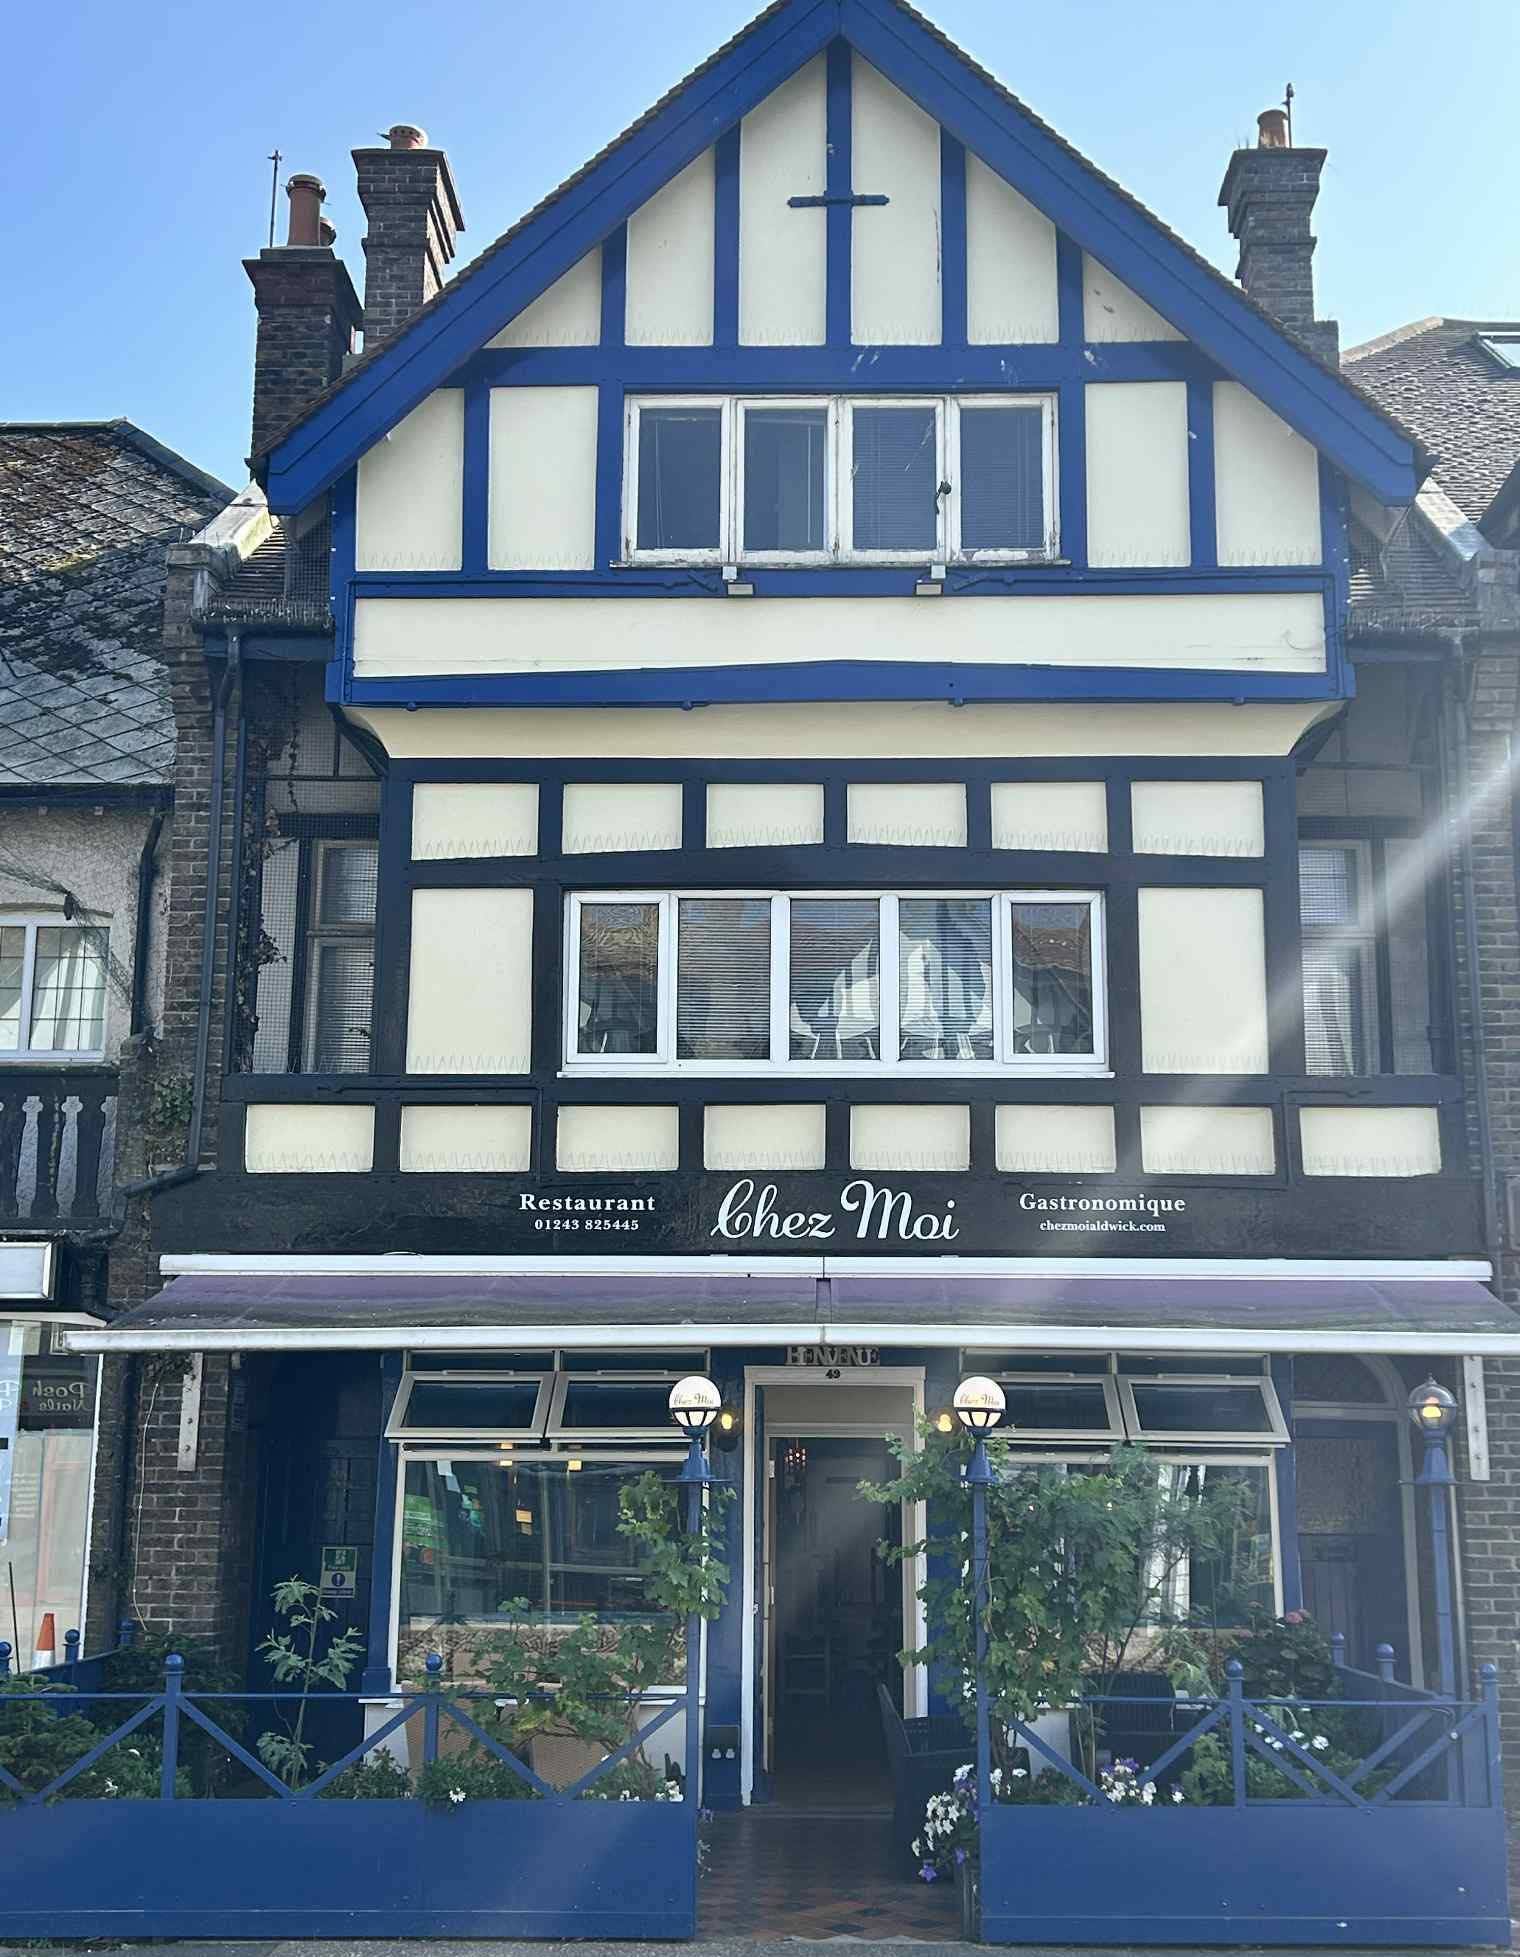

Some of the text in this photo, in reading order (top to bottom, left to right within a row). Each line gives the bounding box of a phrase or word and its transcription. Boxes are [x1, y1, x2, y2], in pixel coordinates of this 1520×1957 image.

[518, 1193, 656, 1211] Restaurant
[710, 1178, 960, 1240] Chez Moi
[1019, 1192, 1186, 1217] Gastronomique
[534, 1219, 639, 1230] 01243 825445
[1039, 1219, 1167, 1232] chezmoialdwick.com
[825, 1368, 841, 1379] 49
